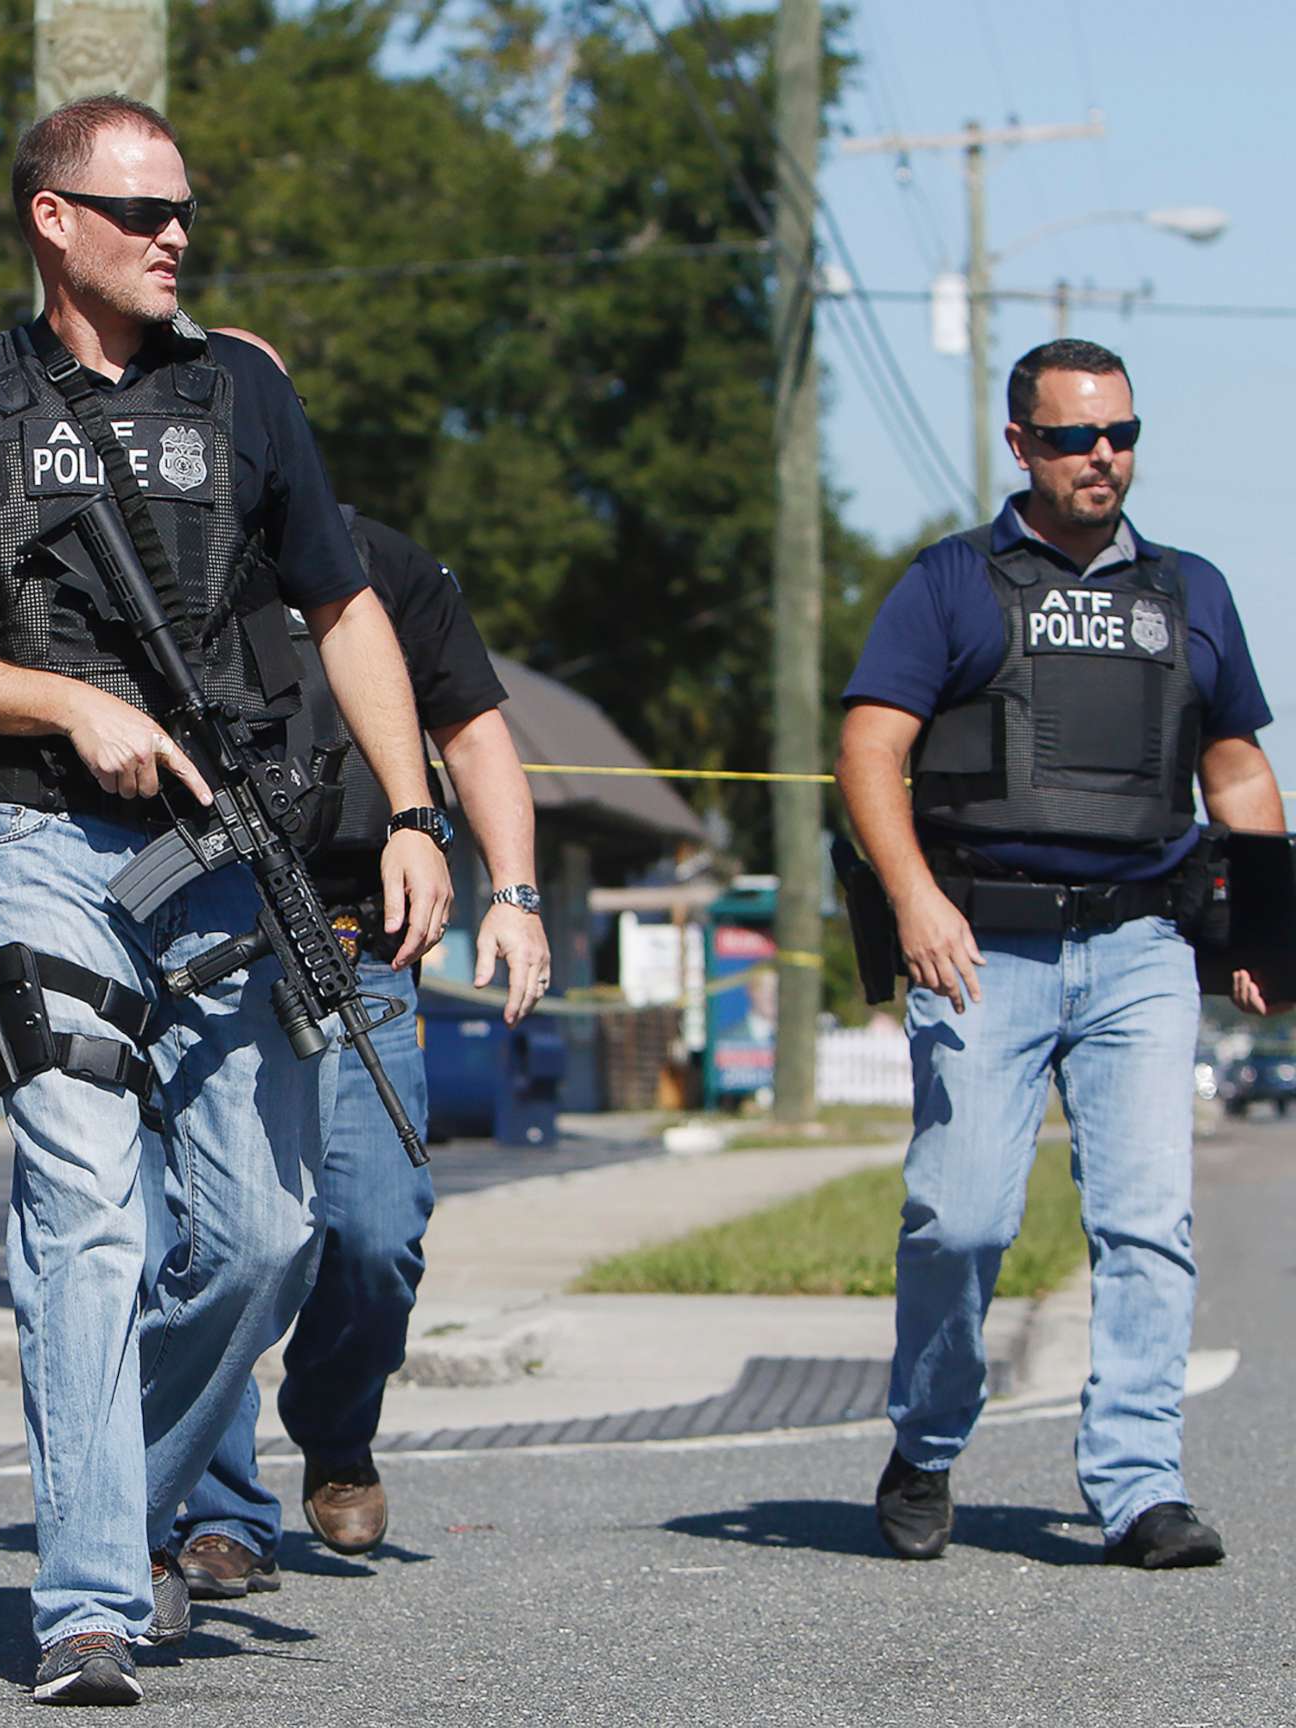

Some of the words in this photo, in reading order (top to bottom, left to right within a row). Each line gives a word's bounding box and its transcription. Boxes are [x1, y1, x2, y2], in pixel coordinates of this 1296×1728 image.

[47, 420, 136, 444] AF
[32, 447, 150, 488] POLIE
[1040, 589, 1113, 613] ATF
[1029, 612, 1125, 650] POLICE
